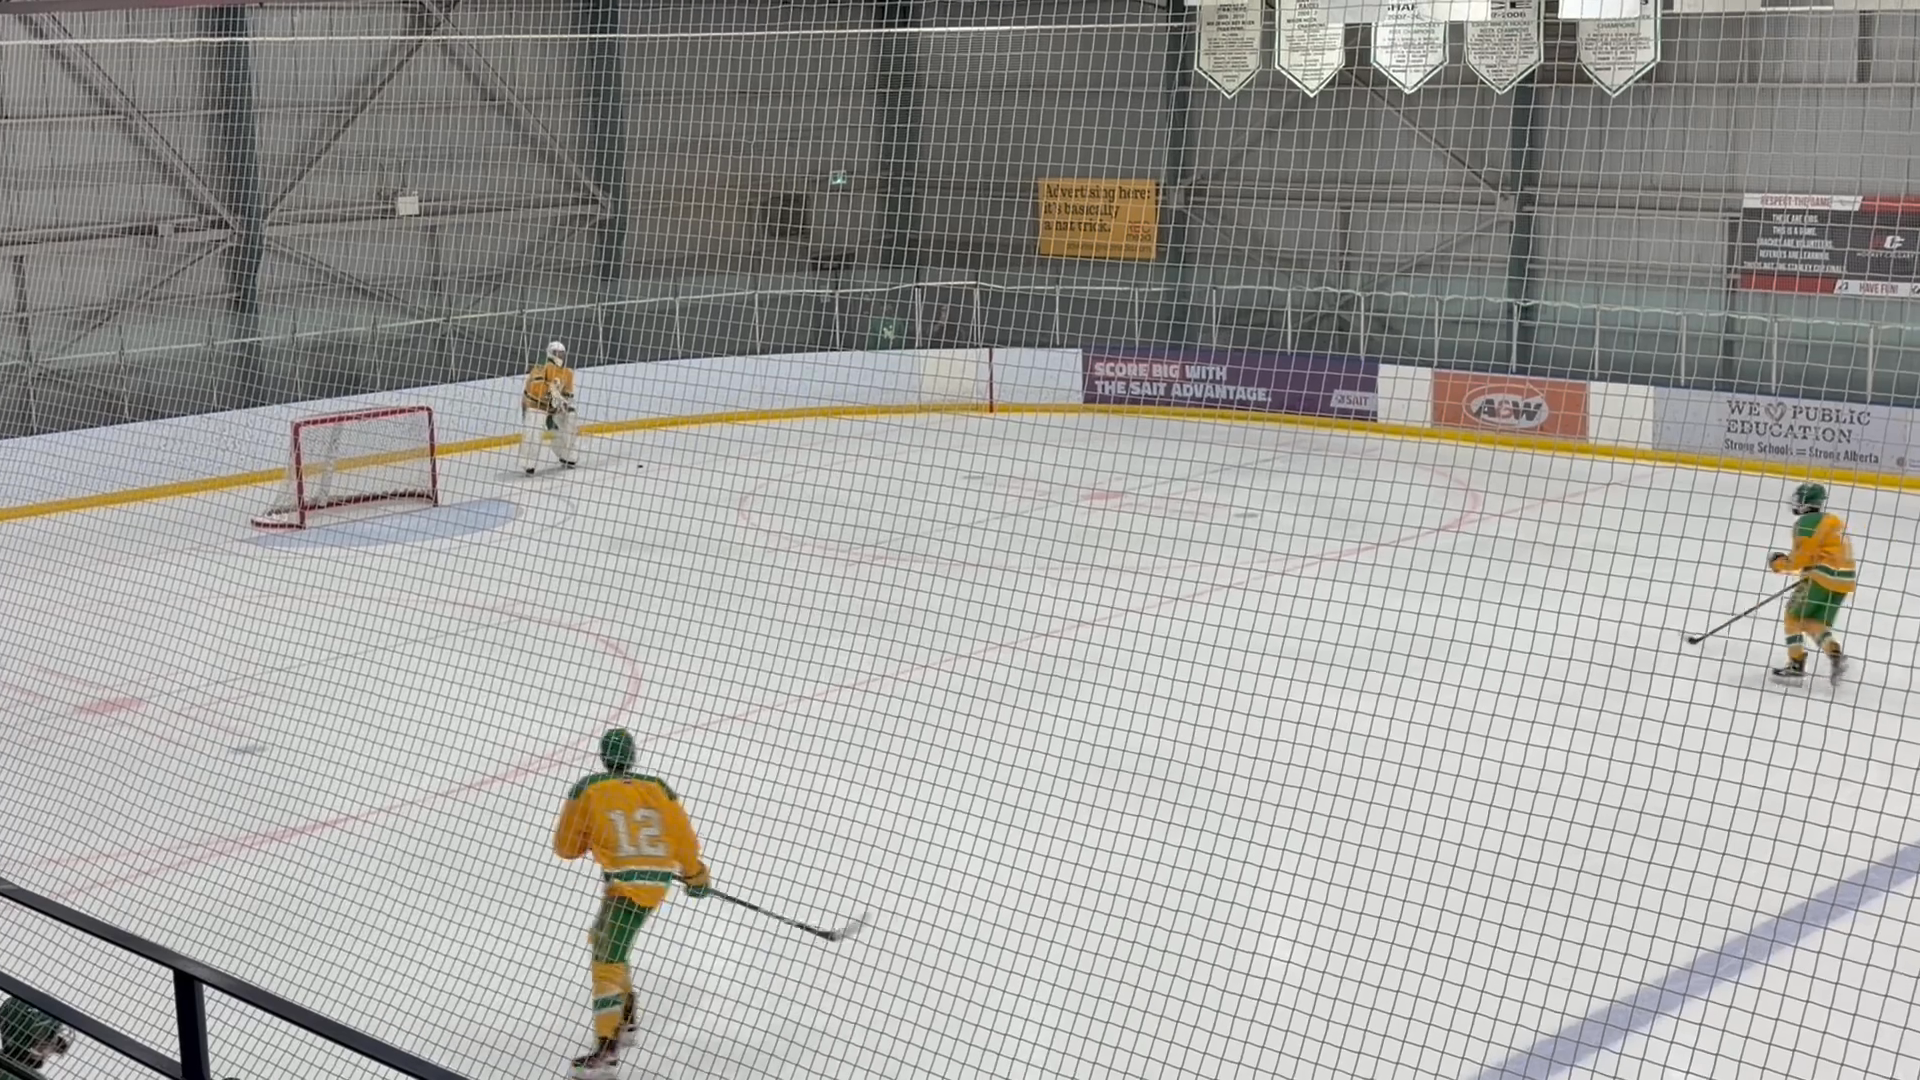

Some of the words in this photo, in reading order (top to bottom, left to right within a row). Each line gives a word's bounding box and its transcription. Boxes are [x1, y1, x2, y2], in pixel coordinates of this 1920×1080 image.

[1046, 184, 1115, 202] Advertising
[1064, 202, 1120, 218] basically
[1055, 220, 1075, 232] hat
[1859, 283, 1879, 294] HAVE
[1095, 362, 1148, 376] SCORE
[1152, 364, 1179, 378] BIG
[1185, 365, 1227, 380] WITH
[1095, 381, 1126, 394] THE
[1131, 382, 1166, 396] SAIT
[1474, 399, 1542, 421] A&W
[1727, 400, 1760, 416] WE
[1792, 405, 1871, 426] PUBLIC
[1726, 419, 1853, 443] EDUCATION
[1724, 439, 1754, 453] Strong
[1757, 442, 1793, 455] Schools
[1808, 447, 1840, 461] Strong
[1843, 451, 1879, 464] Alberta
[606, 808, 670, 858] 12
